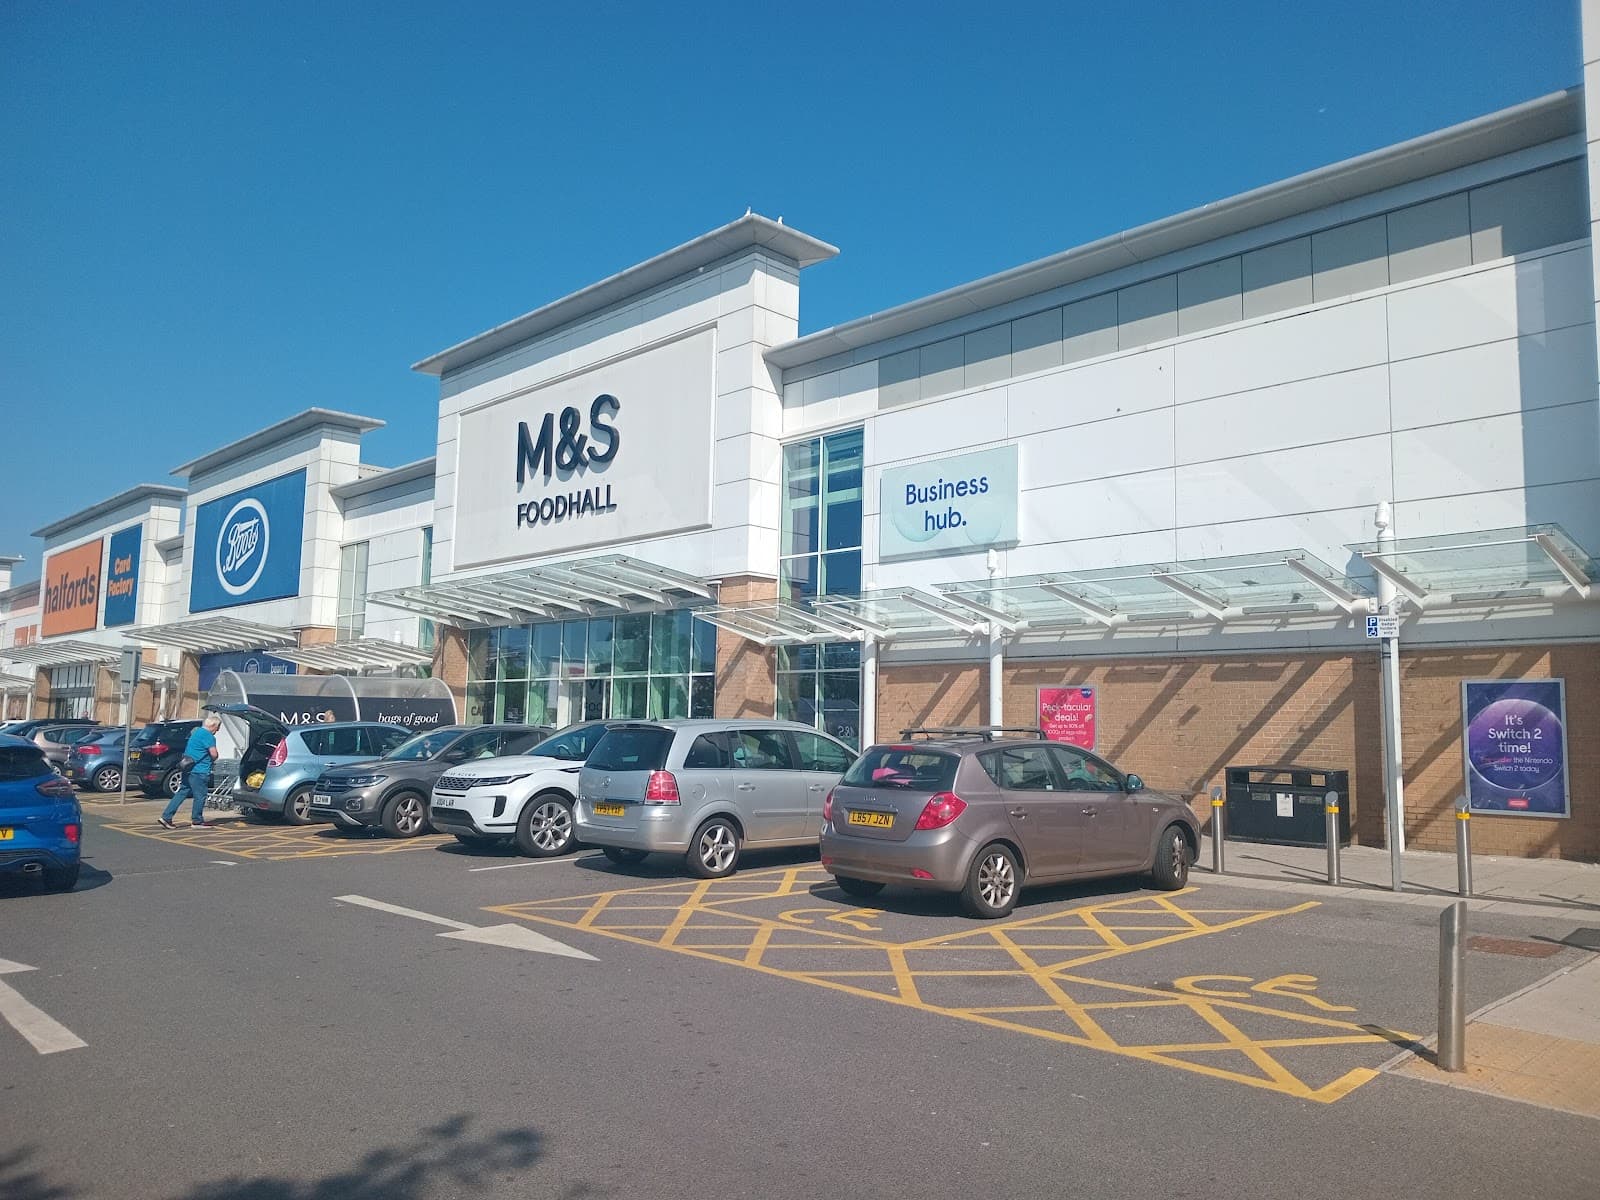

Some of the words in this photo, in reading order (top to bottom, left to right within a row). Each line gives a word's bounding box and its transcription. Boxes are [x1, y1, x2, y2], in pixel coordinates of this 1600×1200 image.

[516, 393, 620, 483] M&S
[905, 476, 989, 506] Business
[517, 484, 618, 527] FOODHALL
[924, 506, 968, 532] hub.
[223, 518, 260, 573] Boots
[113, 554, 131, 576] Card
[43, 566, 96, 616] halfords
[107, 577, 134, 597] Factory
[378, 712, 401, 724] bags
[403, 712, 415, 725] of
[414, 713, 439, 724] good
[1504, 714, 1524, 726] It's
[1488, 727, 1531, 740] Switch
[1533, 727, 1543, 740] 2
[1498, 741, 1532, 754] time!
[1493, 764, 1513, 772] Switch
